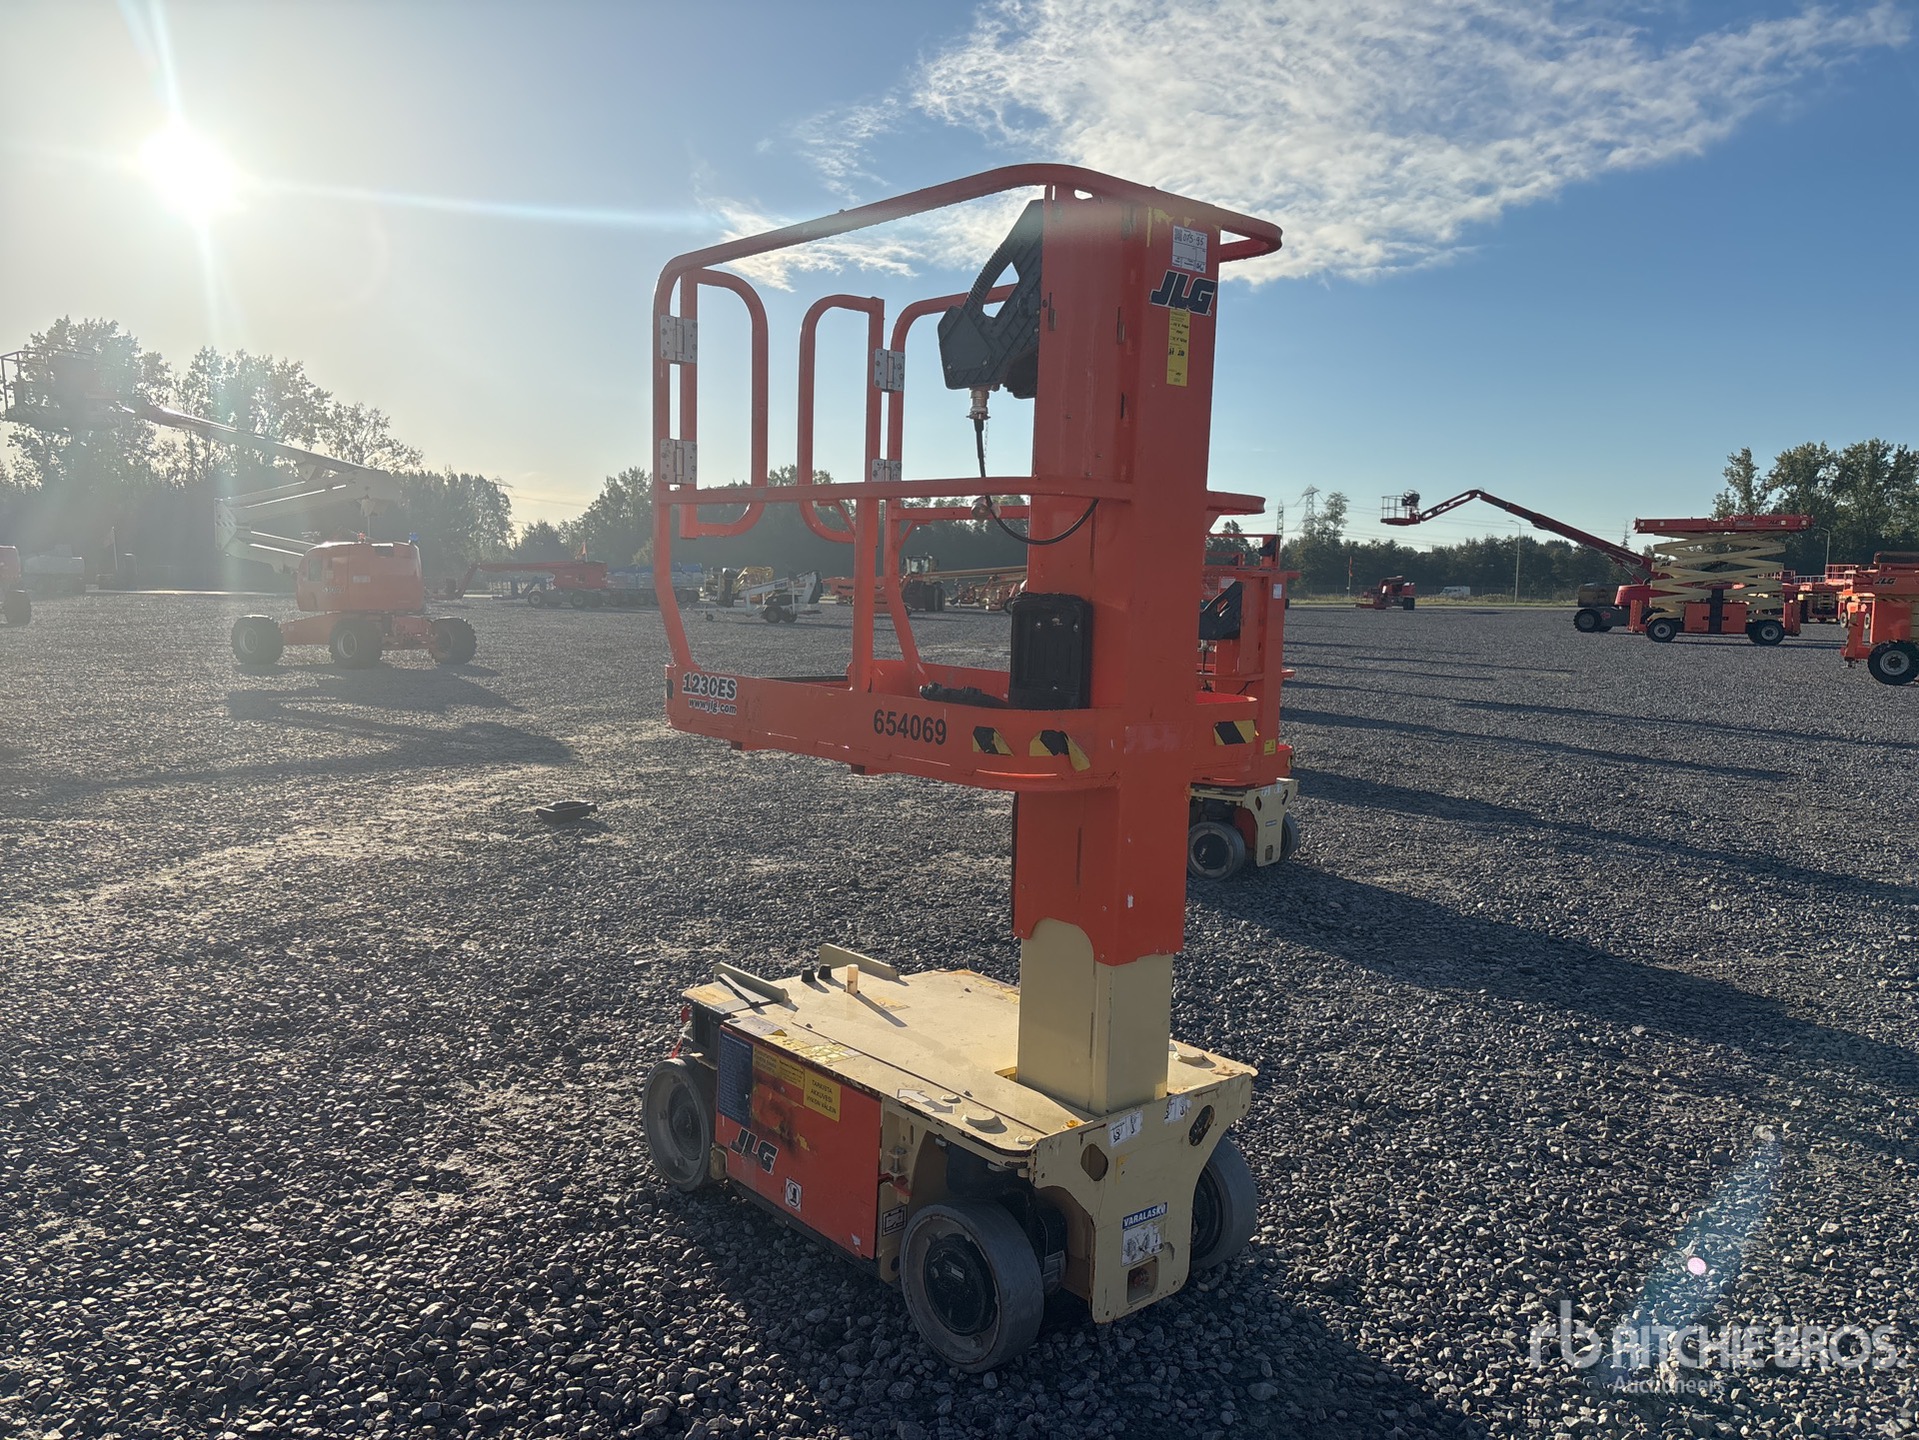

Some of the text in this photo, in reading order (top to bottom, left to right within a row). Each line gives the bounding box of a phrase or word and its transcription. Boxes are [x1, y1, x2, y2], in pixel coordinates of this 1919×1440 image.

[1150, 270, 1217, 315] JLG
[1874, 577, 1898, 586] JLG
[682, 672, 738, 701] 1230ES
[688, 698, 737, 715] www.jlg.com
[873, 709, 947, 745] 654069
[730, 1127, 779, 1175] JLG
